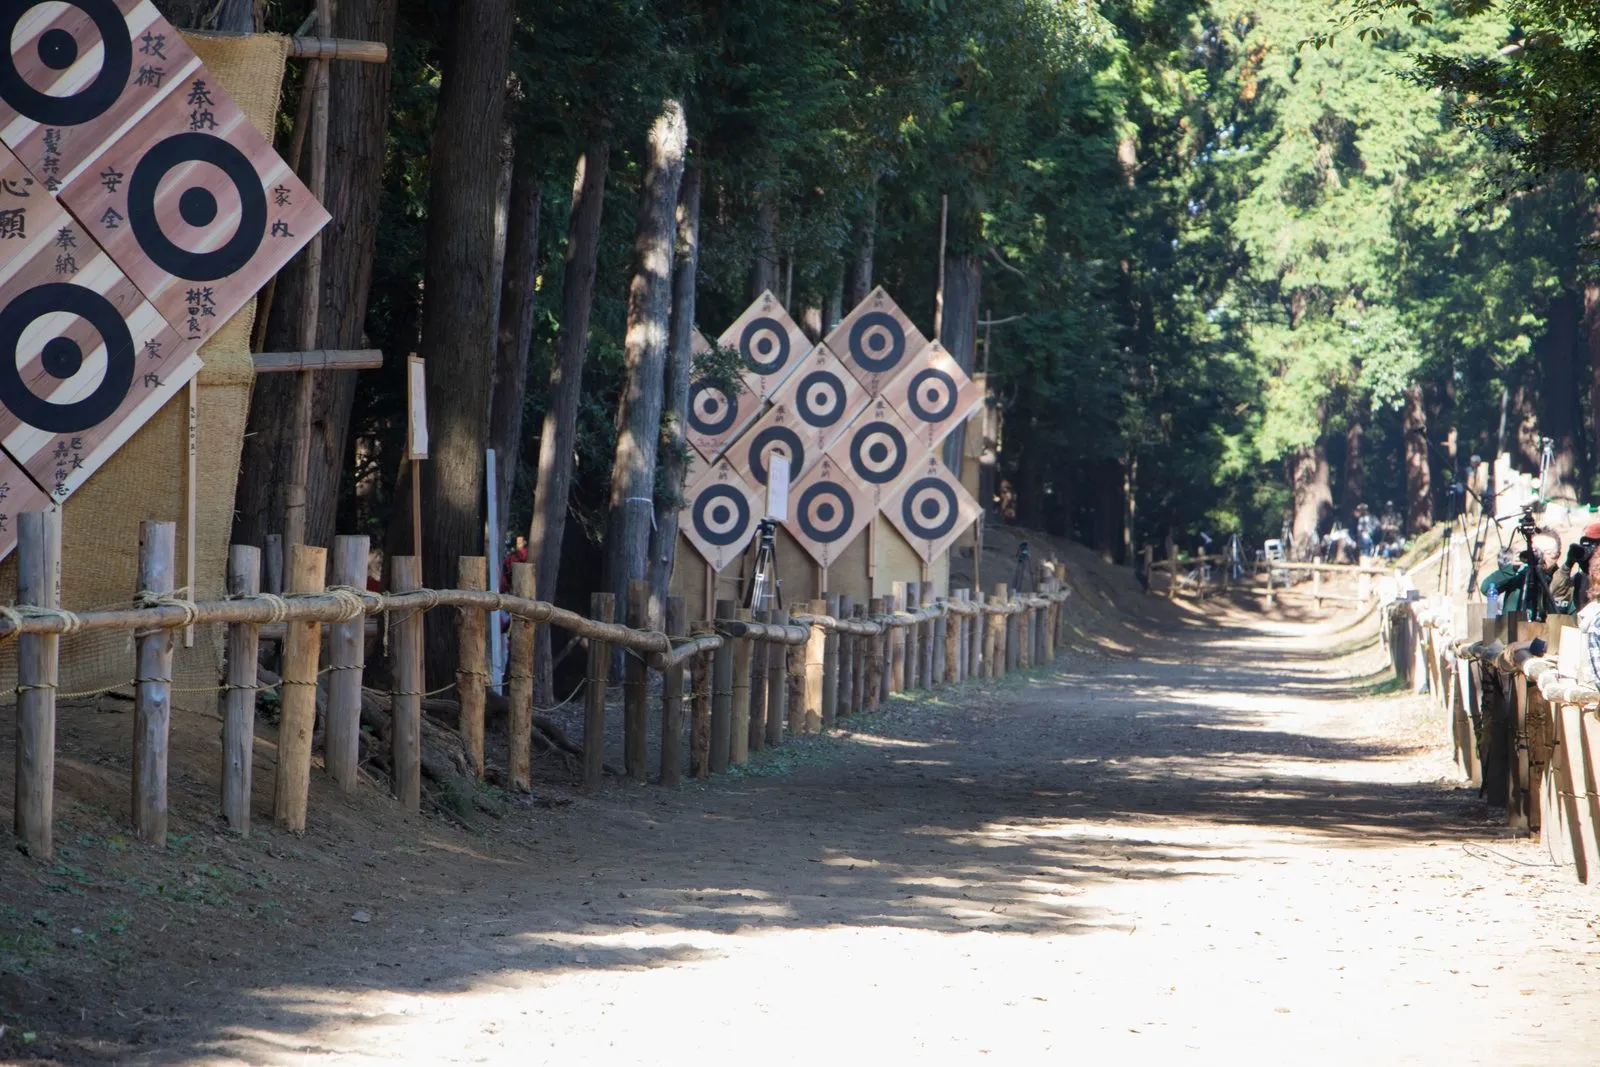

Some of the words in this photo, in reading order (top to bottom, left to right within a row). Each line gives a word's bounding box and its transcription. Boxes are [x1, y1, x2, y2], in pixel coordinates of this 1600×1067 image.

[133, 32, 167, 89] 技術
[187, 79, 219, 132] 奉納
[100, 166, 123, 229] 安全
[271, 185, 295, 238] 家内
[55, 226, 80, 275] 奉納
[185, 288, 202, 341] 村田良一
[144, 339, 165, 388] 家内
